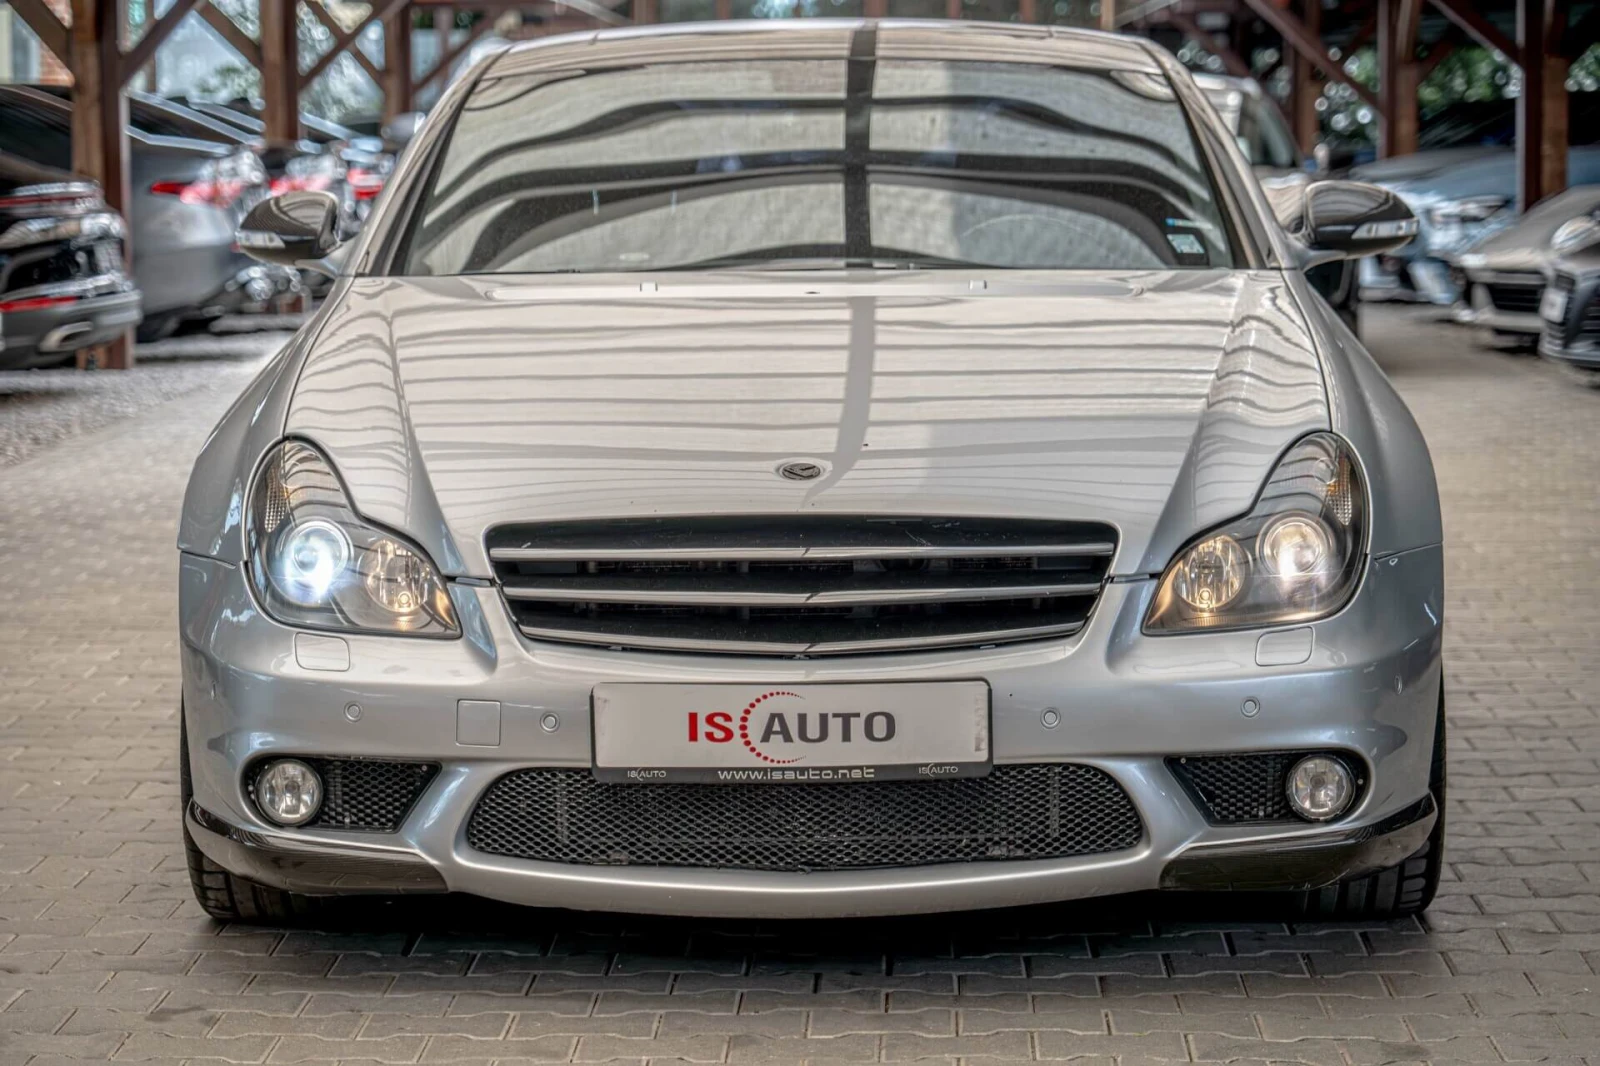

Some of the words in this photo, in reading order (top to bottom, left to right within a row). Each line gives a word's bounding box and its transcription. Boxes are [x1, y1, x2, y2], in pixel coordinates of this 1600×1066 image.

[688, 712, 734, 743] IS
[760, 711, 896, 743] AUTO
[717, 767, 875, 780] www.isauto.net
